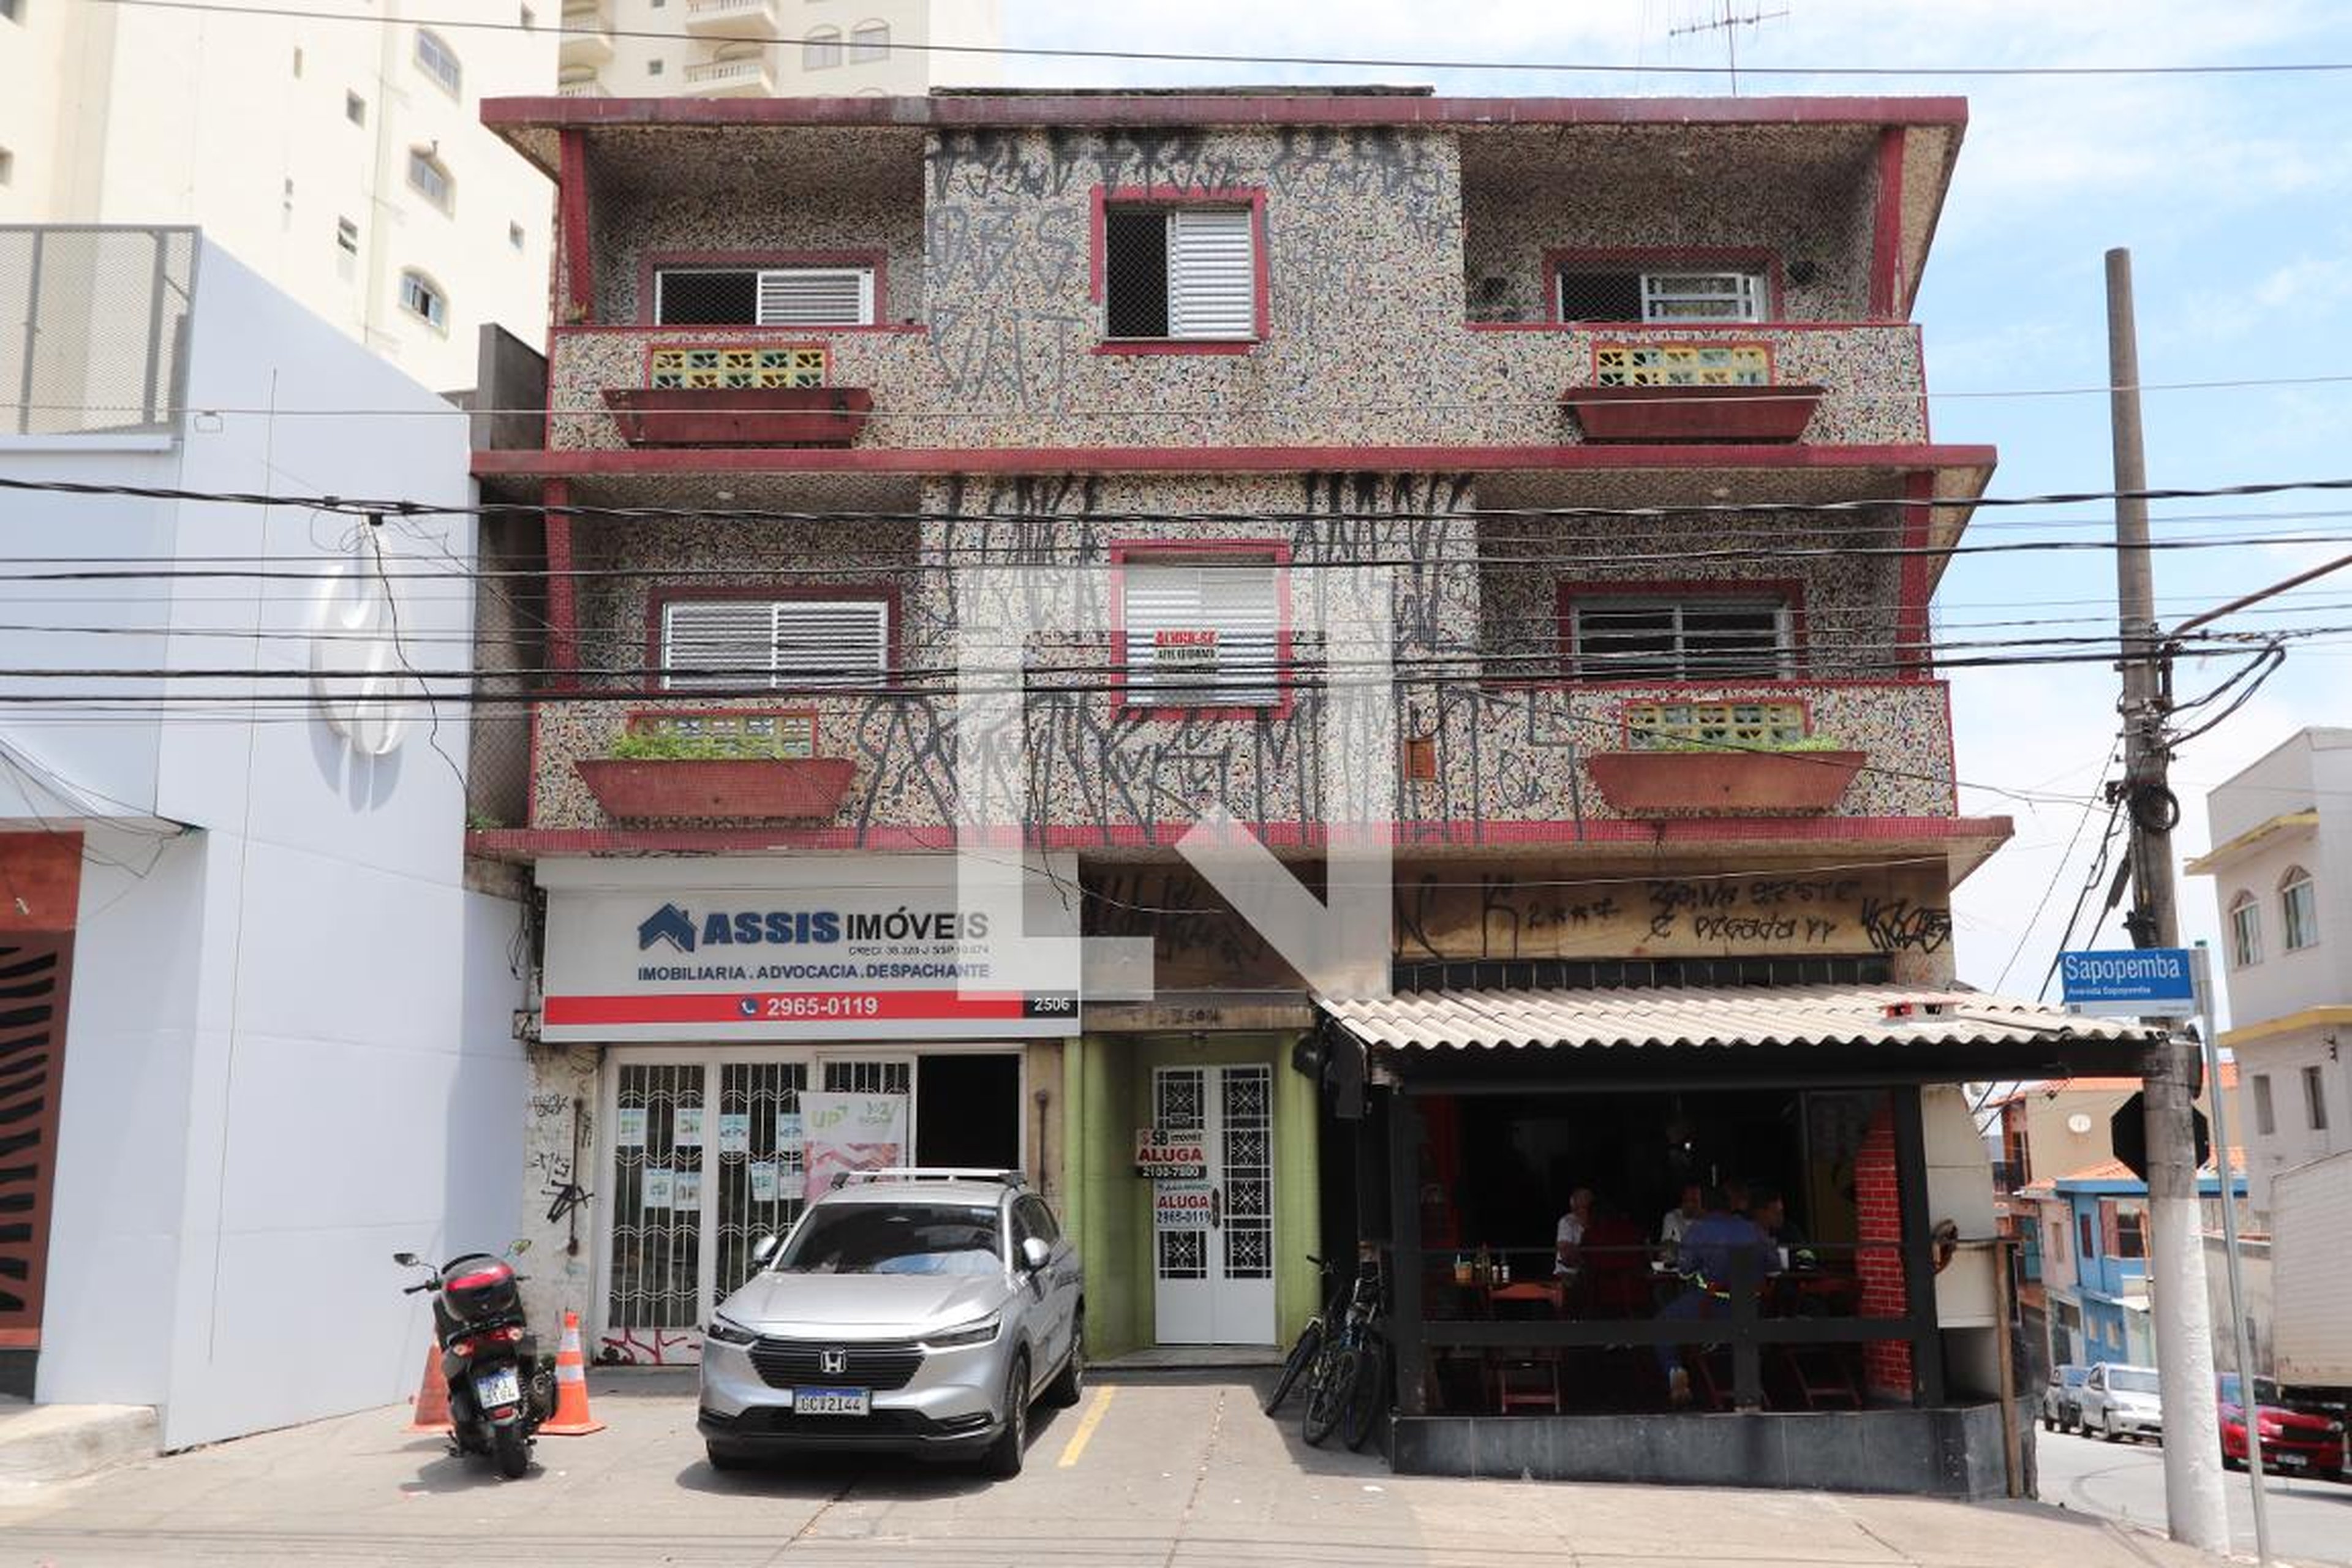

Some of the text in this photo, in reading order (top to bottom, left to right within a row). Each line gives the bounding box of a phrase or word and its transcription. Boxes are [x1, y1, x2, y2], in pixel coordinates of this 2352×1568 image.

[702, 906, 989, 945] ASSIS IMÓVEIS
[2065, 954, 2180, 984] Sapopemba
[766, 997, 878, 1017] 2965-0119
[1033, 998, 1070, 1012] 2506
[1138, 1148, 1204, 1163] ALUGA
[1157, 1196, 1209, 1209] ALUGA
